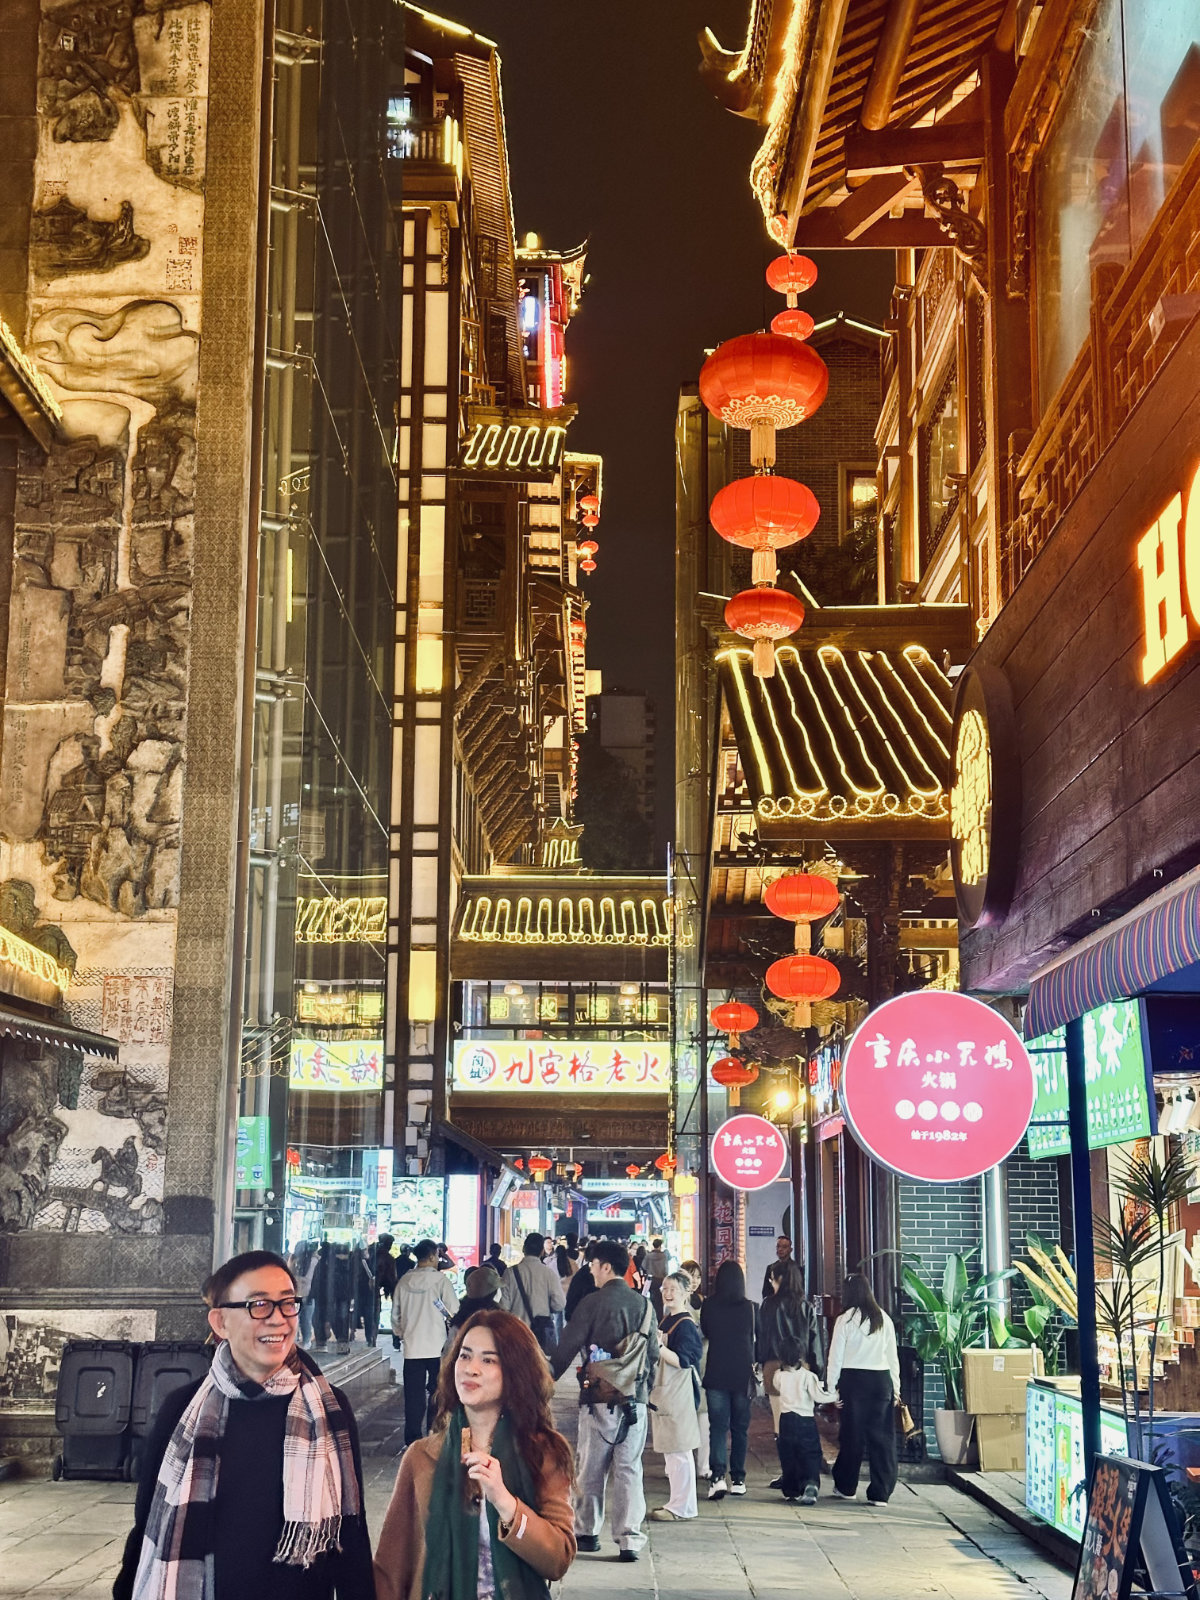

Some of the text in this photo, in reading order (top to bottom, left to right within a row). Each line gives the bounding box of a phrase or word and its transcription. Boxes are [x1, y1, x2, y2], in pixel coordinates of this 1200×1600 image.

[1137, 463, 1200, 685] H
[865, 1033, 1013, 1071] 重庆小天鹅
[921, 1071, 957, 1089] 火锅
